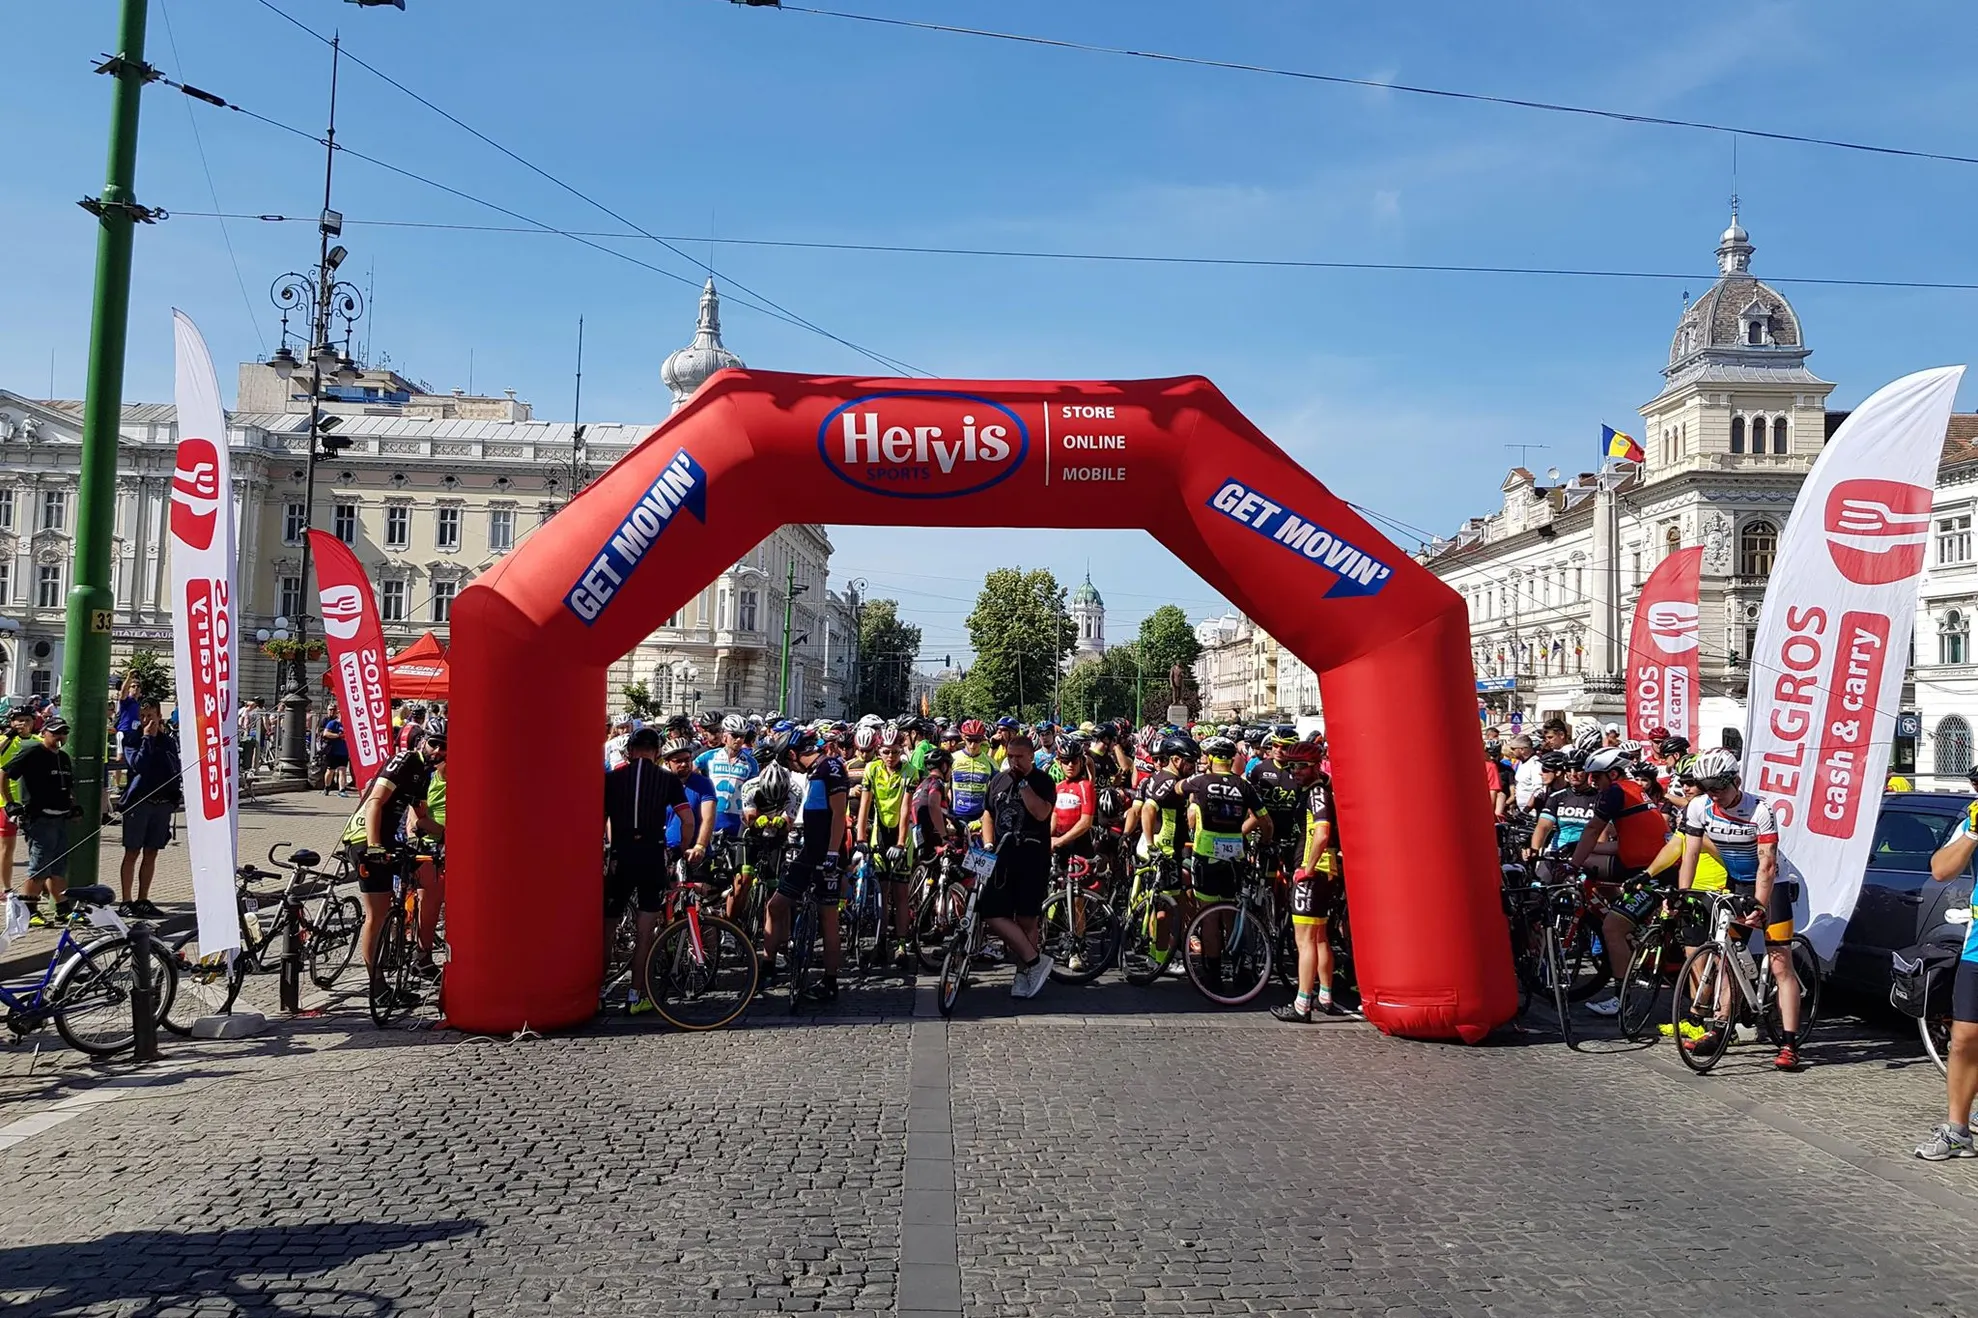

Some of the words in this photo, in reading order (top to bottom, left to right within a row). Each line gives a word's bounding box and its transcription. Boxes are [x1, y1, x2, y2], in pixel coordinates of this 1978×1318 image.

[1062, 406, 1115, 419] STORE
[842, 412, 1010, 473] Hervis
[1062, 435, 1126, 450] ONLINE
[866, 467, 931, 481] SPORTS
[1062, 467, 1126, 481] MOBILE
[570, 553, 623, 620] GET
[611, 452, 696, 566] MOVIN'
[1213, 483, 1282, 529] GET
[1273, 515, 1391, 586] MOVIN'
[96, 612, 112, 630] 33
[1842, 627, 1881, 712] carry
[1671, 674, 1685, 716] carry
[1831, 719, 1860, 743] &
[1155, 779, 1174, 797] CTA
[1207, 783, 1243, 798] CTA
[1823, 751, 1854, 820] cash
[1313, 786, 1326, 813] CTA
[1557, 806, 1595, 819] BORA
[1710, 826, 1757, 836] CUBE
[1294, 882, 1308, 911] CTA
